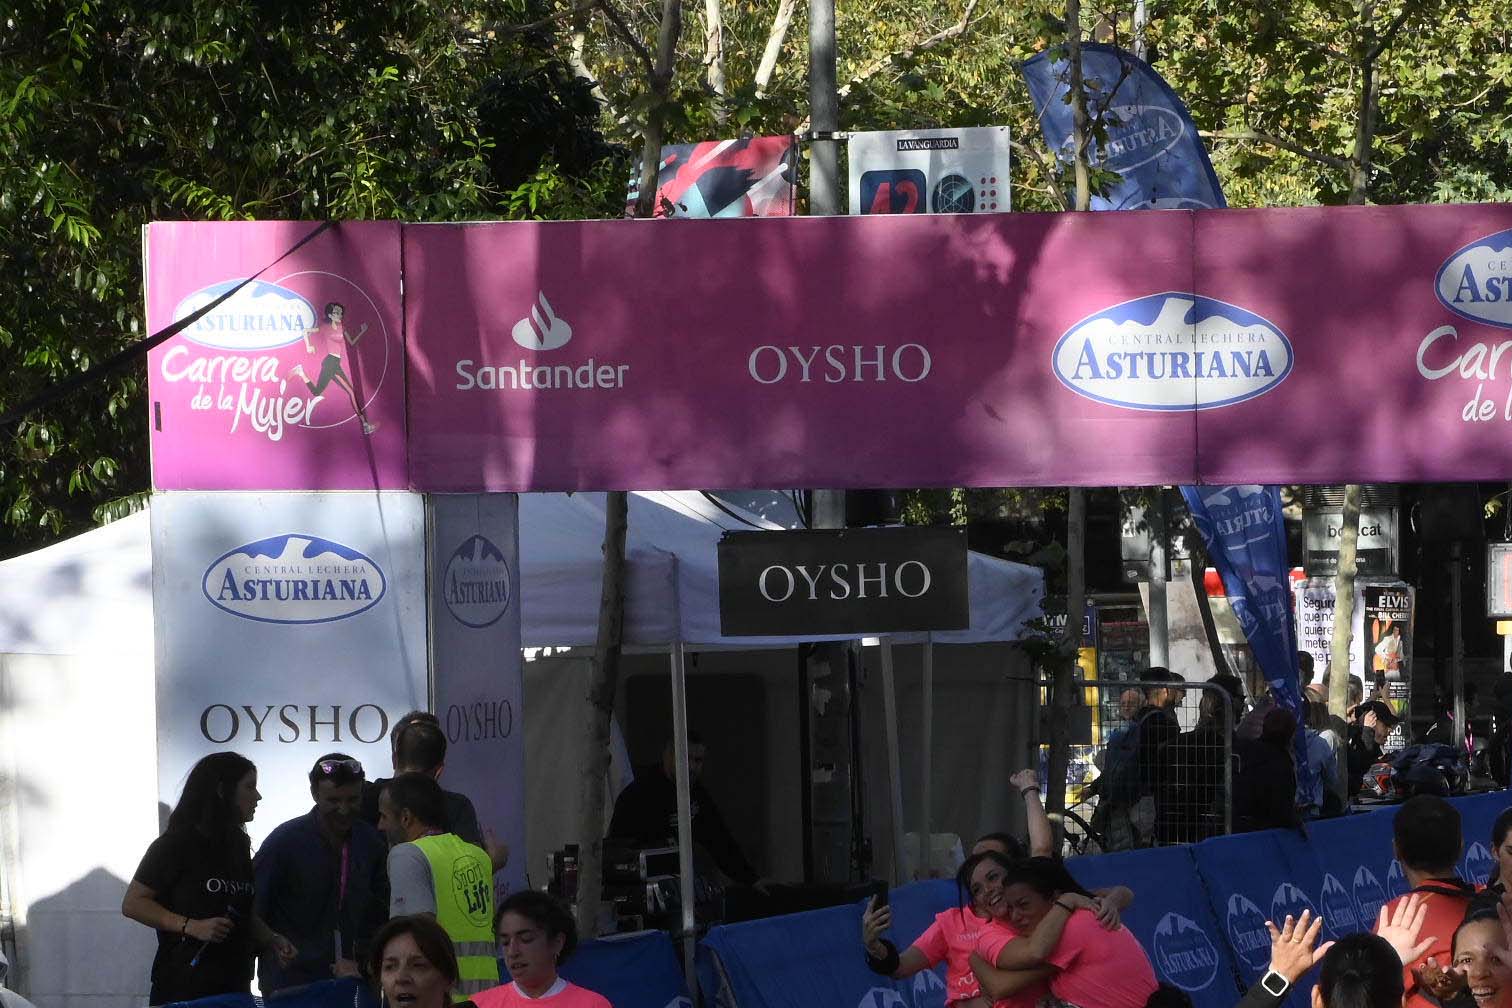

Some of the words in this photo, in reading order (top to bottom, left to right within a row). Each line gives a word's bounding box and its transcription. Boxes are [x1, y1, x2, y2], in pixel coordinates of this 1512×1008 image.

[1108, 333, 1184, 345] CENTRAL
[1191, 331, 1267, 344] LECHERA
[161, 345, 281, 383] Carrera
[455, 358, 630, 391] Santander
[748, 343, 933, 384] OYSHO
[1071, 336, 1275, 381] ASTURIANA
[191, 386, 214, 411] de
[218, 383, 233, 411] la
[231, 372, 324, 441] Mujer
[1461, 383, 1497, 423] de
[218, 568, 372, 602] ASTURIANA
[244, 565, 304, 575] CENTRAL
[309, 563, 367, 574] LECHERA
[450, 569, 507, 606] ASTURIANA
[758, 559, 931, 602] OYSHO
[1378, 595, 1409, 608] ELVIS
[199, 703, 389, 744] OYSHO
[447, 700, 513, 743] OYSHO
[463, 881, 491, 916] Life
